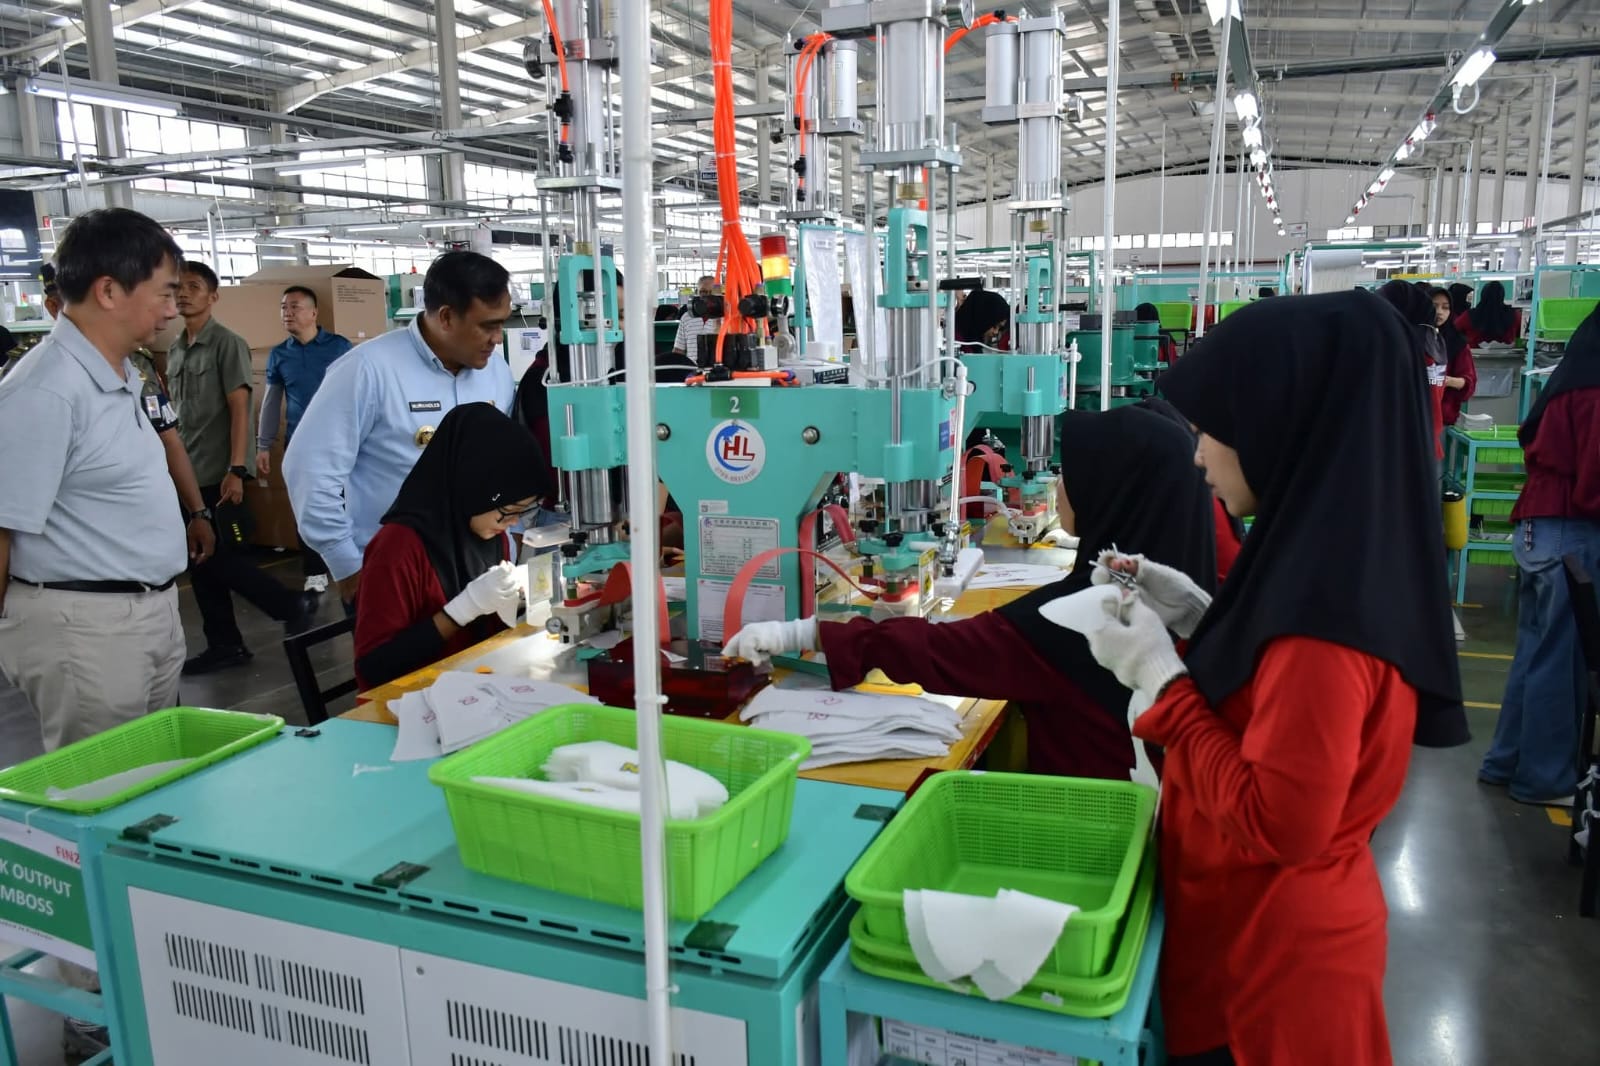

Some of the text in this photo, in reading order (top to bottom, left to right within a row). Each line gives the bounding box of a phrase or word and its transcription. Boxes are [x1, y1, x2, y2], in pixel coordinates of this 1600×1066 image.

[729, 396, 740, 413] 2
[723, 435, 756, 461] HL
[12, 863, 72, 898] OUTPUT
